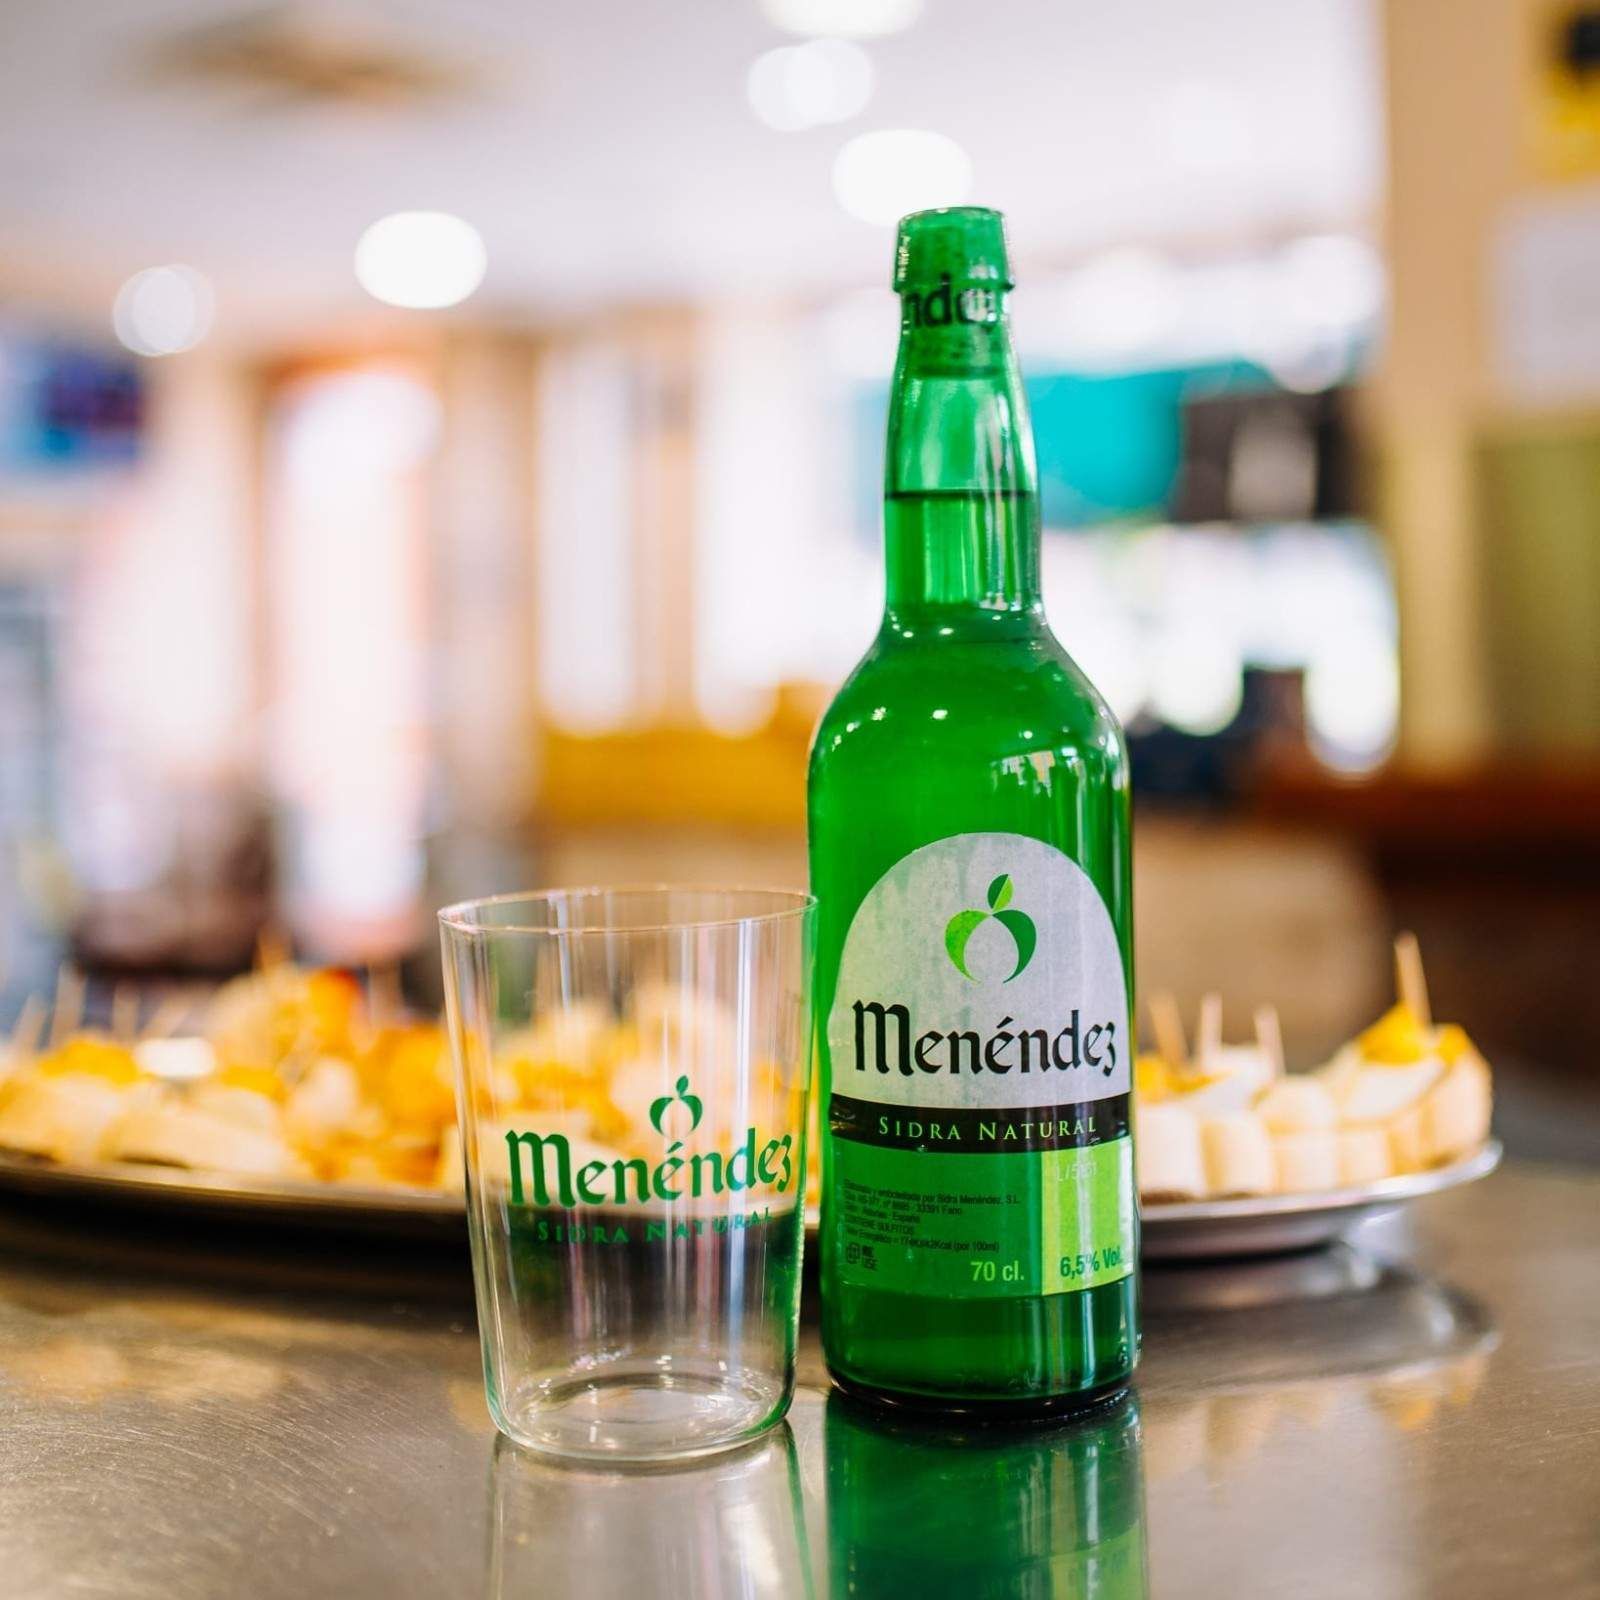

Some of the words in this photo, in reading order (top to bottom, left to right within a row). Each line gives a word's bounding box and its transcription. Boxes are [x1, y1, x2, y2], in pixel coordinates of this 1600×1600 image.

[852, 1000, 1117, 1077] Menéndez
[879, 1116, 961, 1141] SIDRA
[978, 1116, 1097, 1141] NATURAL
[505, 1128, 792, 1208] Menéndez
[538, 1220, 630, 1244] SIDRA
[646, 1206, 773, 1242] NATURAL
[970, 1261, 996, 1282] 70
[1002, 1260, 1025, 1281] cl.
[1060, 1249, 1100, 1280] 6,5%
